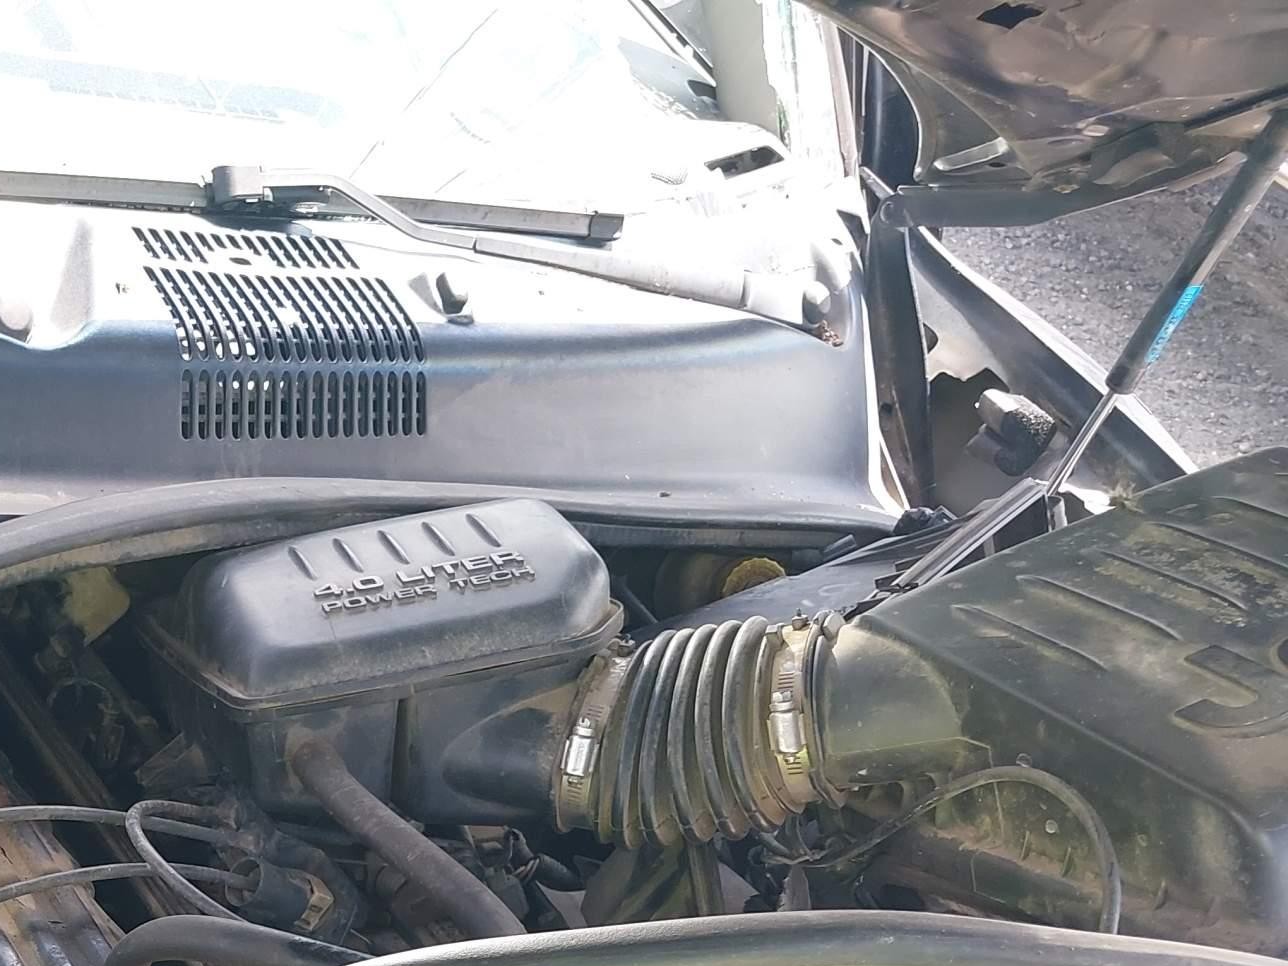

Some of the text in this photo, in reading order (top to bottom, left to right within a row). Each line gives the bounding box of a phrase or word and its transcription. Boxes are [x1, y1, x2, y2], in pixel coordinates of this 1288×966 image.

[313, 551, 526, 598] 4.0 LITER
[321, 565, 536, 614] POWER TECH
